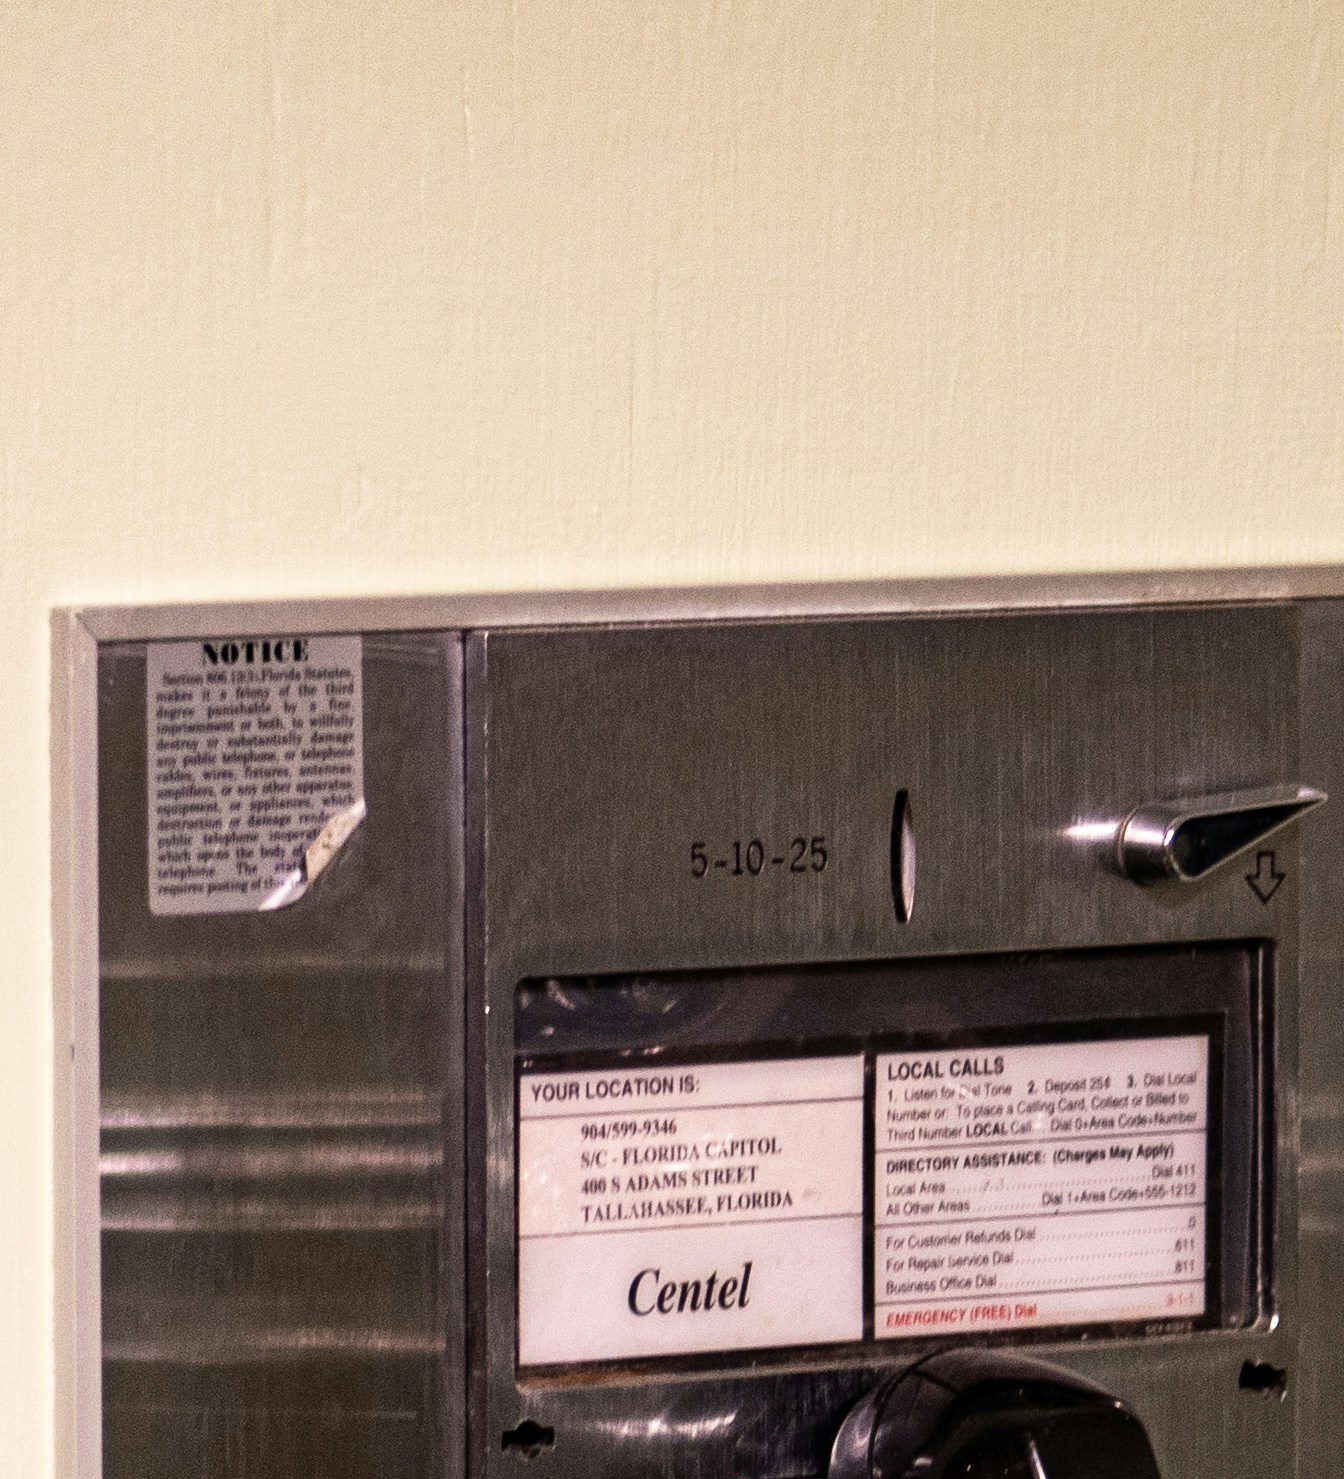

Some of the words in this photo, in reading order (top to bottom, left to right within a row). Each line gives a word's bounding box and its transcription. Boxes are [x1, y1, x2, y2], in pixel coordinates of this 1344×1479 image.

[202, 640, 308, 665] NOTICE
[326, 682, 353, 695] third
[691, 835, 828, 878] 5-10-25
[888, 1060, 944, 1081] LOCAL
[949, 1056, 1004, 1077] CALLS
[531, 1081, 579, 1102] YOUR
[585, 1077, 674, 1100] LOCATION
[679, 1075, 700, 1094] IS:
[905, 1087, 937, 1101] Listen
[941, 1086, 955, 1099] for
[984, 1082, 1012, 1097] Tone
[1045, 1077, 1087, 1093] Deposit
[1144, 1072, 1165, 1087] Dial
[1168, 1070, 1197, 1085] Local
[887, 1109, 931, 1122] Number
[957, 1104, 970, 1119] To
[974, 1103, 1004, 1120] place
[1007, 1104, 1013, 1115] a
[1017, 1099, 1055, 1116] Calling
[1091, 1095, 1129, 1109] Collect
[1132, 1095, 1143, 1107] or
[1146, 1091, 1176, 1107] Billed
[1178, 1092, 1190, 1105] to
[581, 1118, 677, 1141] 904/599-9346
[889, 1127, 915, 1142] Third
[918, 1126, 963, 1141] Number
[966, 1122, 1006, 1138] LOCAL
[1051, 1116, 1072, 1132] Dial
[580, 1151, 607, 1170] S/C
[622, 1143, 701, 1166] FLORIDA
[706, 1136, 782, 1161] CAPITOL
[886, 1156, 959, 1175] DIRECTORY
[1053, 1148, 1106, 1165] (Charges
[1109, 1145, 1133, 1163] May
[1136, 1141, 1174, 1160] Apply)
[581, 1177, 606, 1195] 400
[611, 1175, 620, 1193] S
[627, 1170, 688, 1192] ADAMS
[692, 1165, 759, 1187] STREET
[886, 1182, 916, 1197] Local
[920, 1181, 946, 1195] Area
[1152, 1164, 1173, 1179] Dial
[581, 1196, 713, 1224] TALLAHASSEE,
[716, 1190, 793, 1213] FLORIDA
[886, 1203, 900, 1216] All
[903, 1200, 935, 1215] Other
[938, 1199, 970, 1213] Areas
[1042, 1190, 1063, 1206] Dial
[886, 1236, 904, 1250] For
[908, 1233, 962, 1249] Customer
[965, 1229, 1011, 1245] Refunds
[1014, 1226, 1036, 1242] Dial
[886, 1258, 905, 1273] For
[908, 1256, 944, 1273] Repair
[992, 1251, 1014, 1266] Dial
[627, 1261, 753, 1317] Centel
[886, 1279, 936, 1295] Business
[939, 1276, 972, 1291] Office
[975, 1274, 997, 1289] Dial
[886, 1308, 967, 1328] EMERGENCY
[969, 1304, 1012, 1324] (FREE)
[1014, 1303, 1037, 1318] Dial
